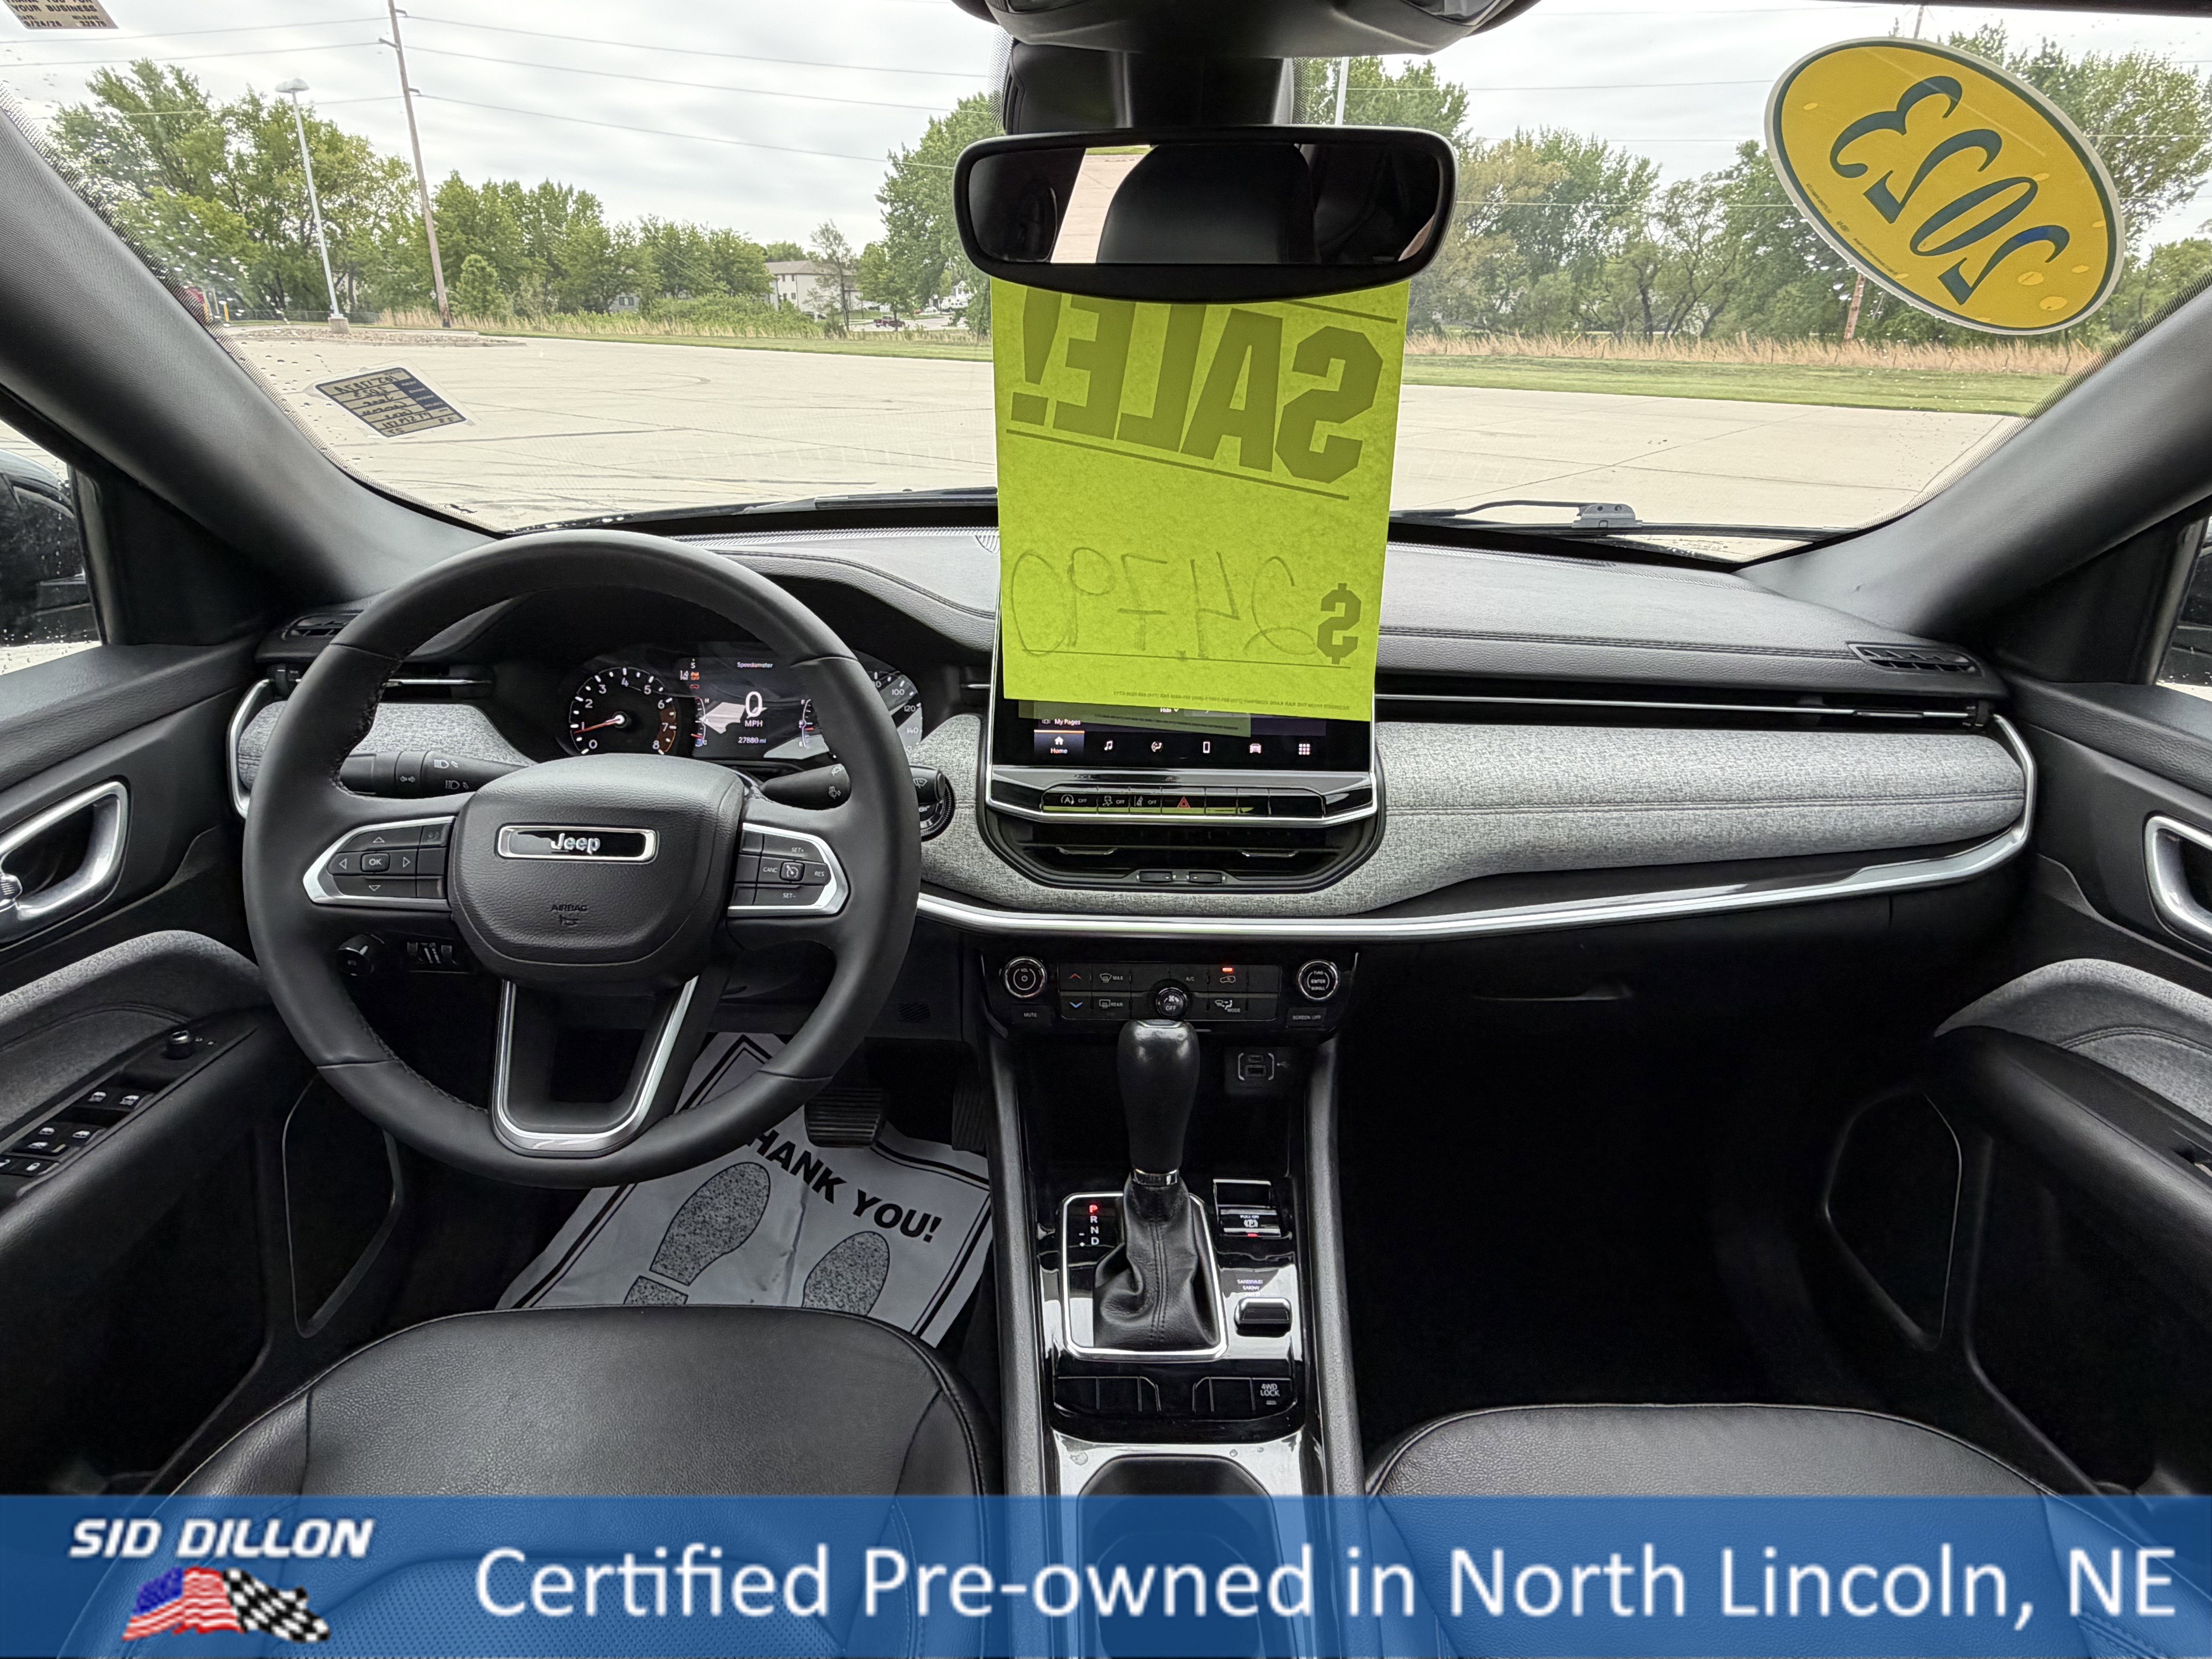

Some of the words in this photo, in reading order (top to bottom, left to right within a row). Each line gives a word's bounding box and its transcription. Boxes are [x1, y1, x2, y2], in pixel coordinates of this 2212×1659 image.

[621, 677, 629, 687] 4
[599, 684, 607, 694] 3
[644, 685, 651, 695] 5
[585, 699, 593, 708] 2
[658, 699, 665, 709] 6
[745, 691, 763, 717] 0
[662, 723, 668, 732] 7
[589, 739, 598, 749] 0
[653, 740, 660, 750] 8
[551, 833, 601, 855] Jeep
[747, 1129, 847, 1204] HANK
[853, 1188, 942, 1243] YOU!
[1089, 1204, 1098, 1213] P
[1090, 1215, 1098, 1223] R
[1090, 1226, 1099, 1234] N
[1091, 1237, 1100, 1245] D
